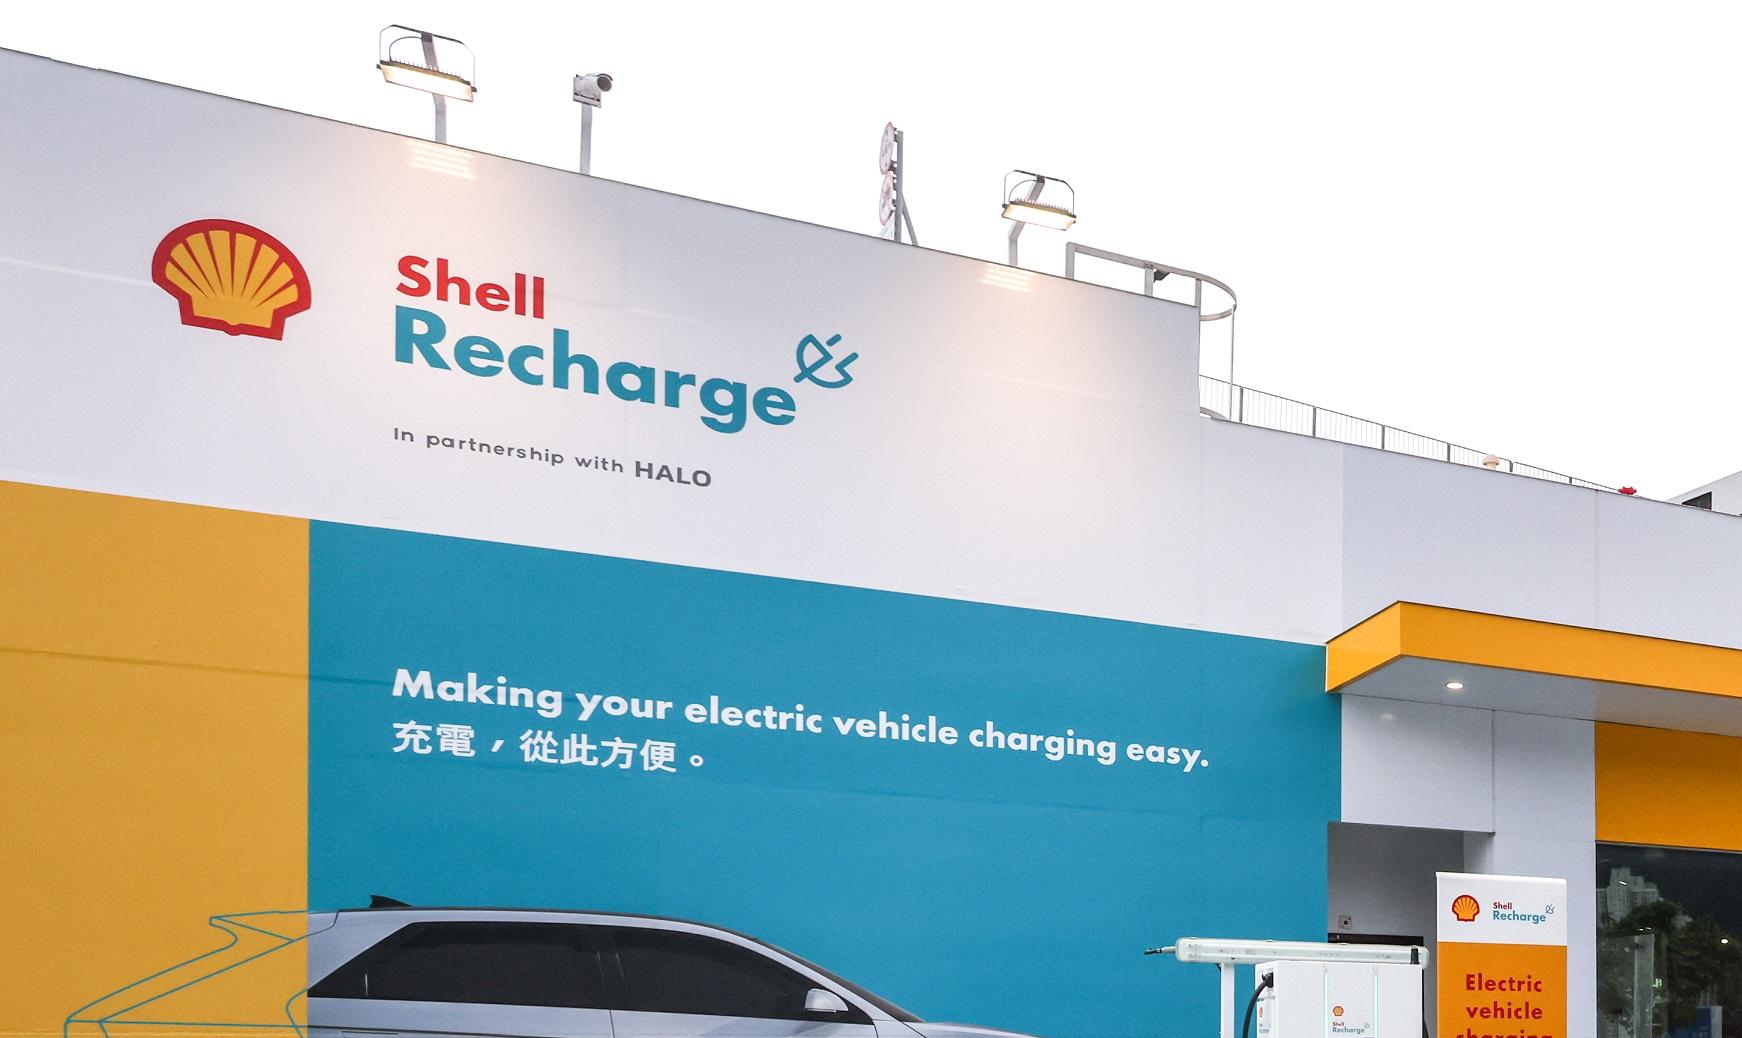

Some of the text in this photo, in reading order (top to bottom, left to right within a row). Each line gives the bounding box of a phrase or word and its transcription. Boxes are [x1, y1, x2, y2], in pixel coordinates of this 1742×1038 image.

[395, 255, 546, 320] Shell
[394, 304, 797, 434] Recharge
[392, 427, 713, 488] In partnership with HALO
[391, 668, 1211, 774] Making your electric vehicle charging easy.
[391, 718, 706, 774] 充電，從此方便。
[1492, 910, 1547, 924] Recharge
[1493, 902, 1512, 911] Shell
[1465, 973, 1543, 993] Electric
[1465, 1001, 1543, 1020] vehicle
[1332, 1026, 1365, 1035] Recharge
